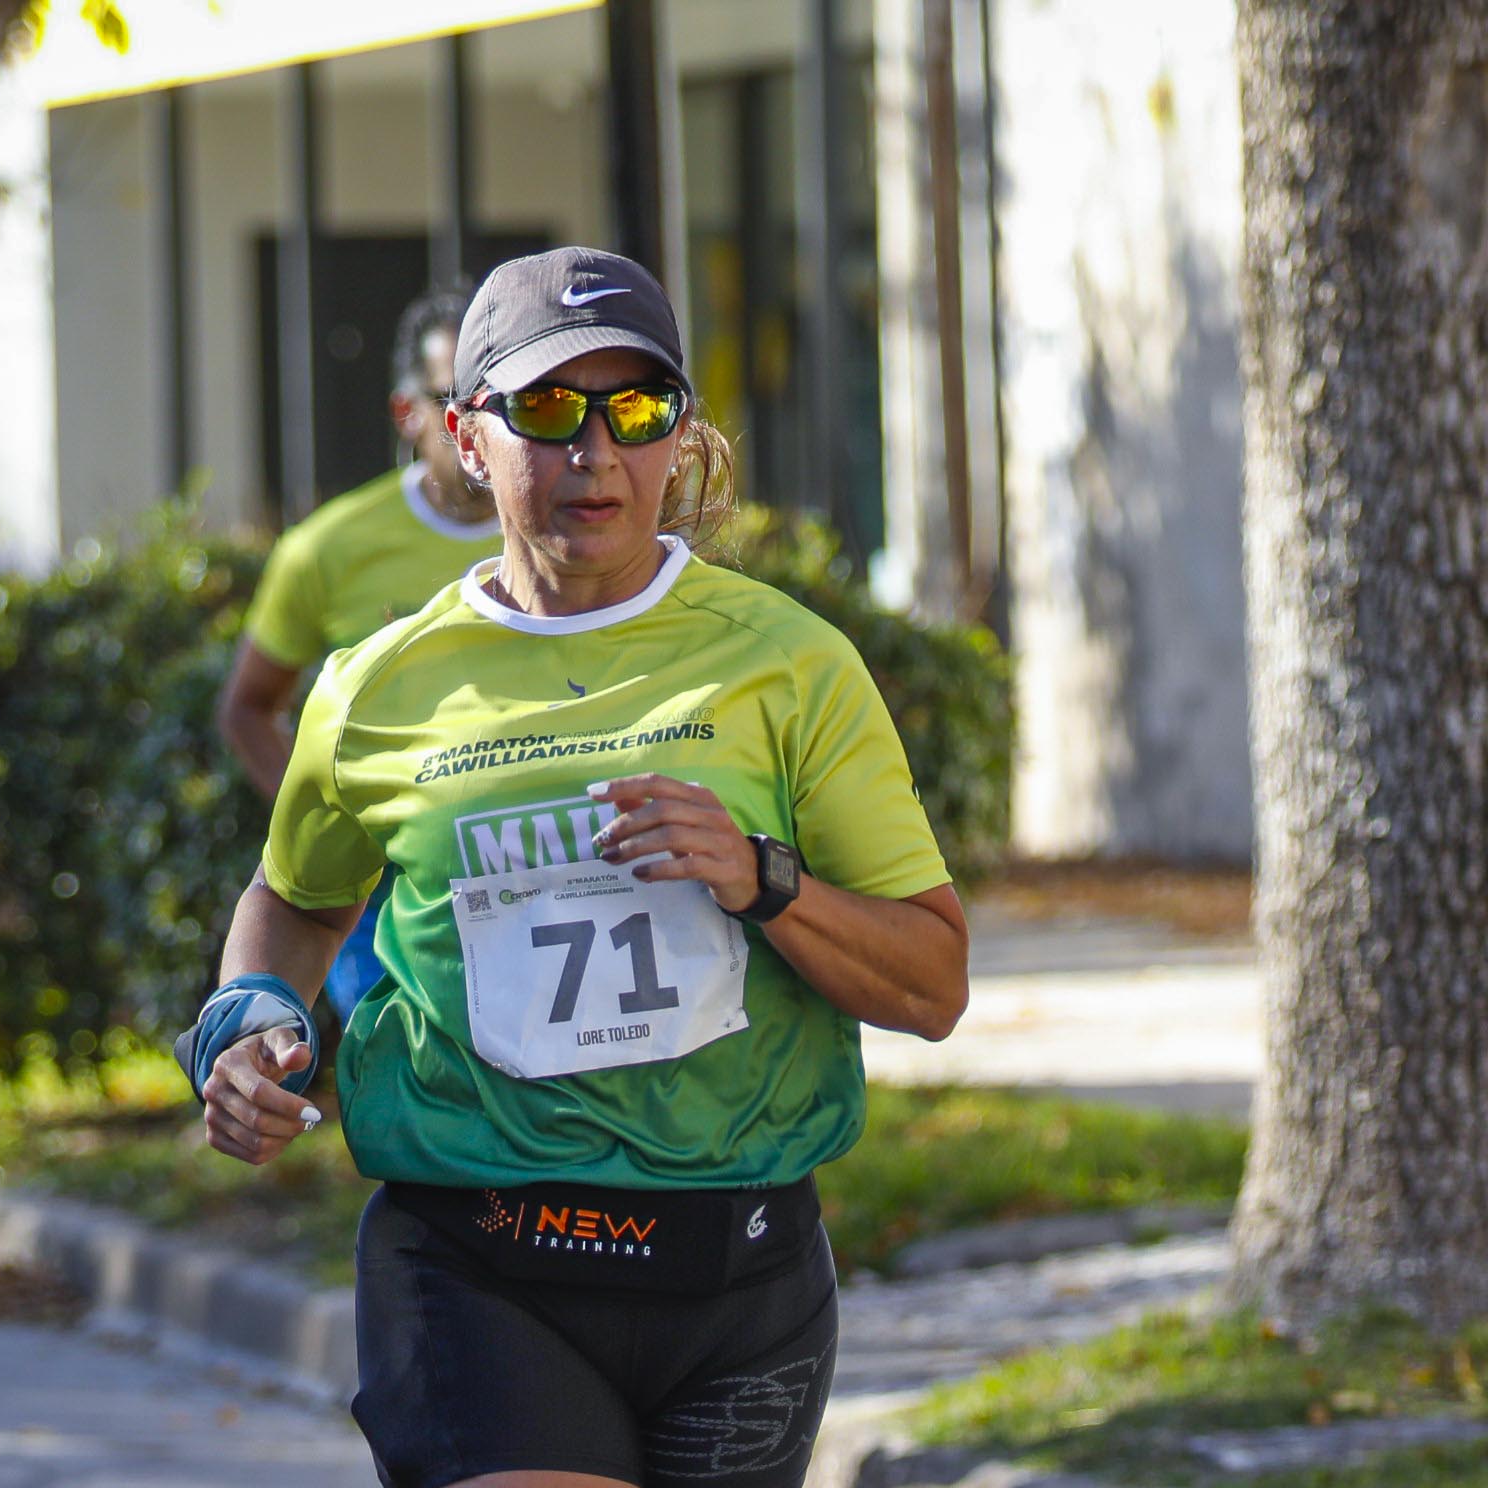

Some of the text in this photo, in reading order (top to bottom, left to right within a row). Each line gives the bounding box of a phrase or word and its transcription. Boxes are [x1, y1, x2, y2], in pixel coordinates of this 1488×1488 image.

[414, 722, 716, 784] CAWILLIAMSKEMMIS
[530, 911, 680, 1024] 71
[576, 1023, 651, 1046] LORE TOLEDO
[536, 1205, 656, 1241] NEW
[534, 1234, 651, 1256] TRAINING
